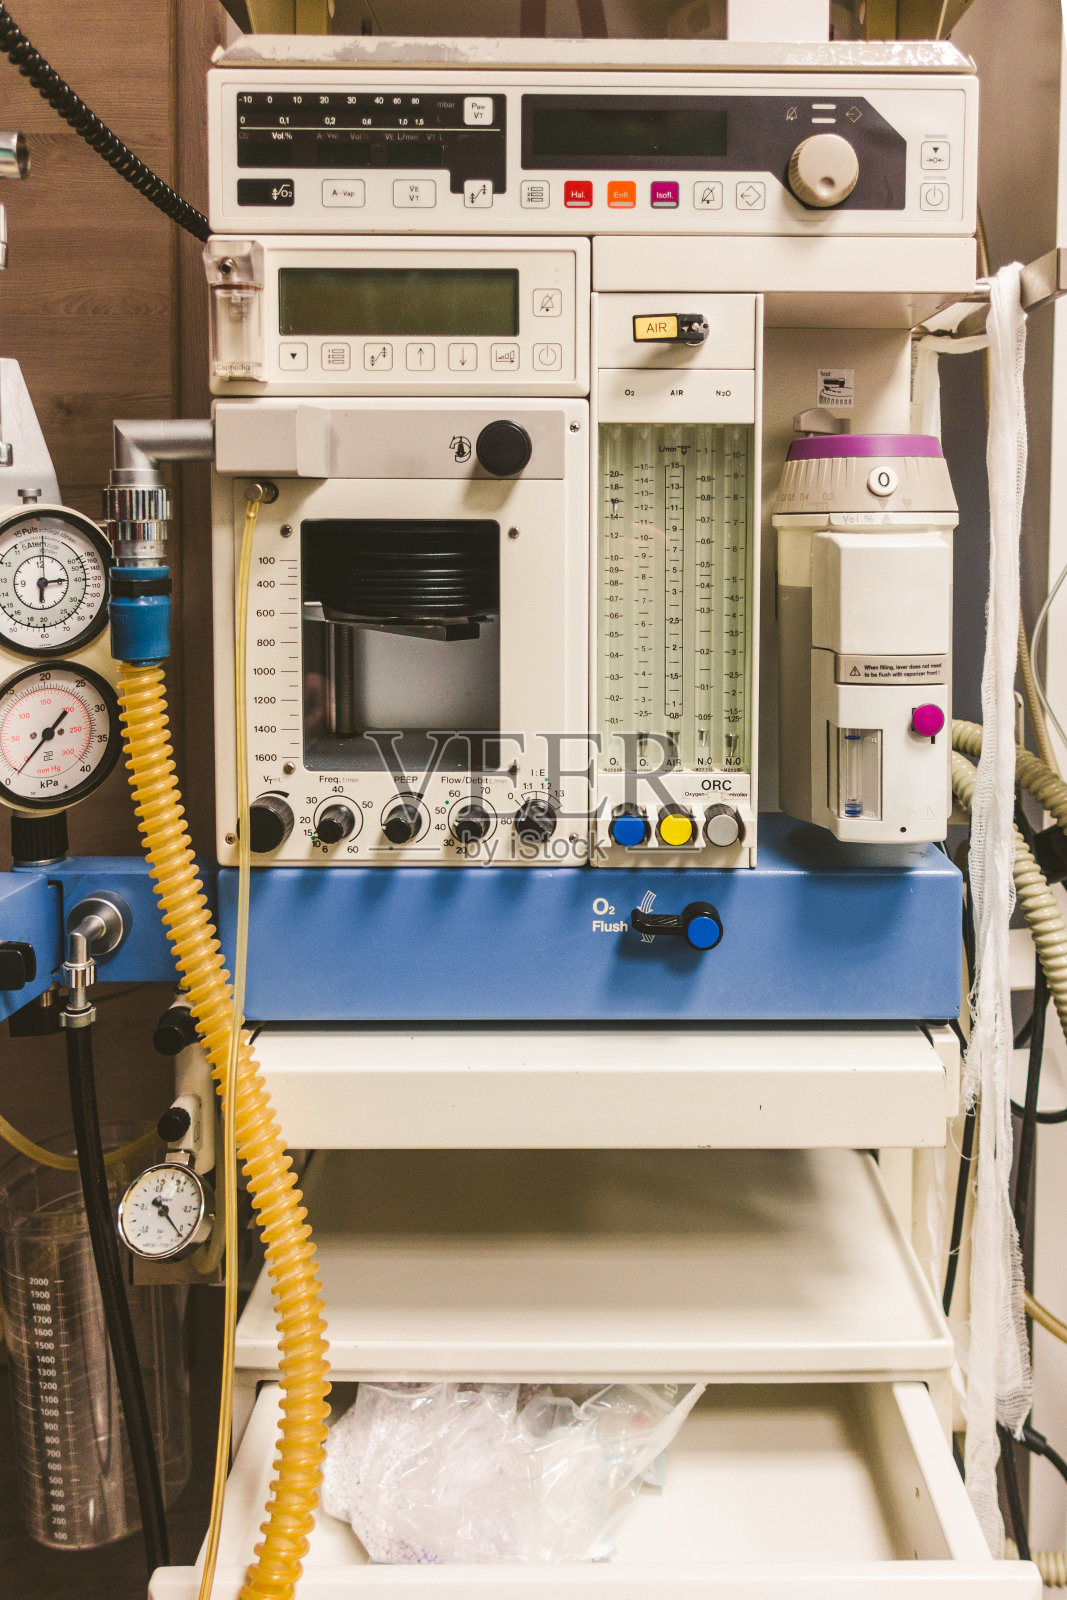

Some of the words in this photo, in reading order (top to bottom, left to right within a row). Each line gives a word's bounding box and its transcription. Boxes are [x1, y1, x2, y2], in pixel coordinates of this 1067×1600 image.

[293, 96, 302, 104] 10
[320, 96, 329, 104] 20
[348, 96, 356, 104] 30
[375, 96, 384, 104] 40
[647, 323, 667, 333] AIR
[878, 472, 890, 487] 0
[40, 673, 51, 681] 20
[95, 704, 105, 712] 30
[40, 780, 58, 788] kPa
[441, 776, 488, 784] Flow/Debit
[701, 780, 732, 790] ORC
[592, 898, 615, 915] O2
[592, 920, 628, 932] Flush
[29, 1278, 48, 1286] 2000
[31, 1290, 50, 1299] 1900
[32, 1303, 51, 1312] 1800
[33, 1316, 52, 1324] 1700
[34, 1328, 53, 1336] 1600
[36, 1341, 54, 1350] 1500
[37, 1355, 55, 1364] 1400
[38, 1369, 56, 1377] 1300
[39, 1382, 57, 1390] 1200
[40, 1395, 58, 1404] 1100
[41, 1408, 59, 1417] 1000
